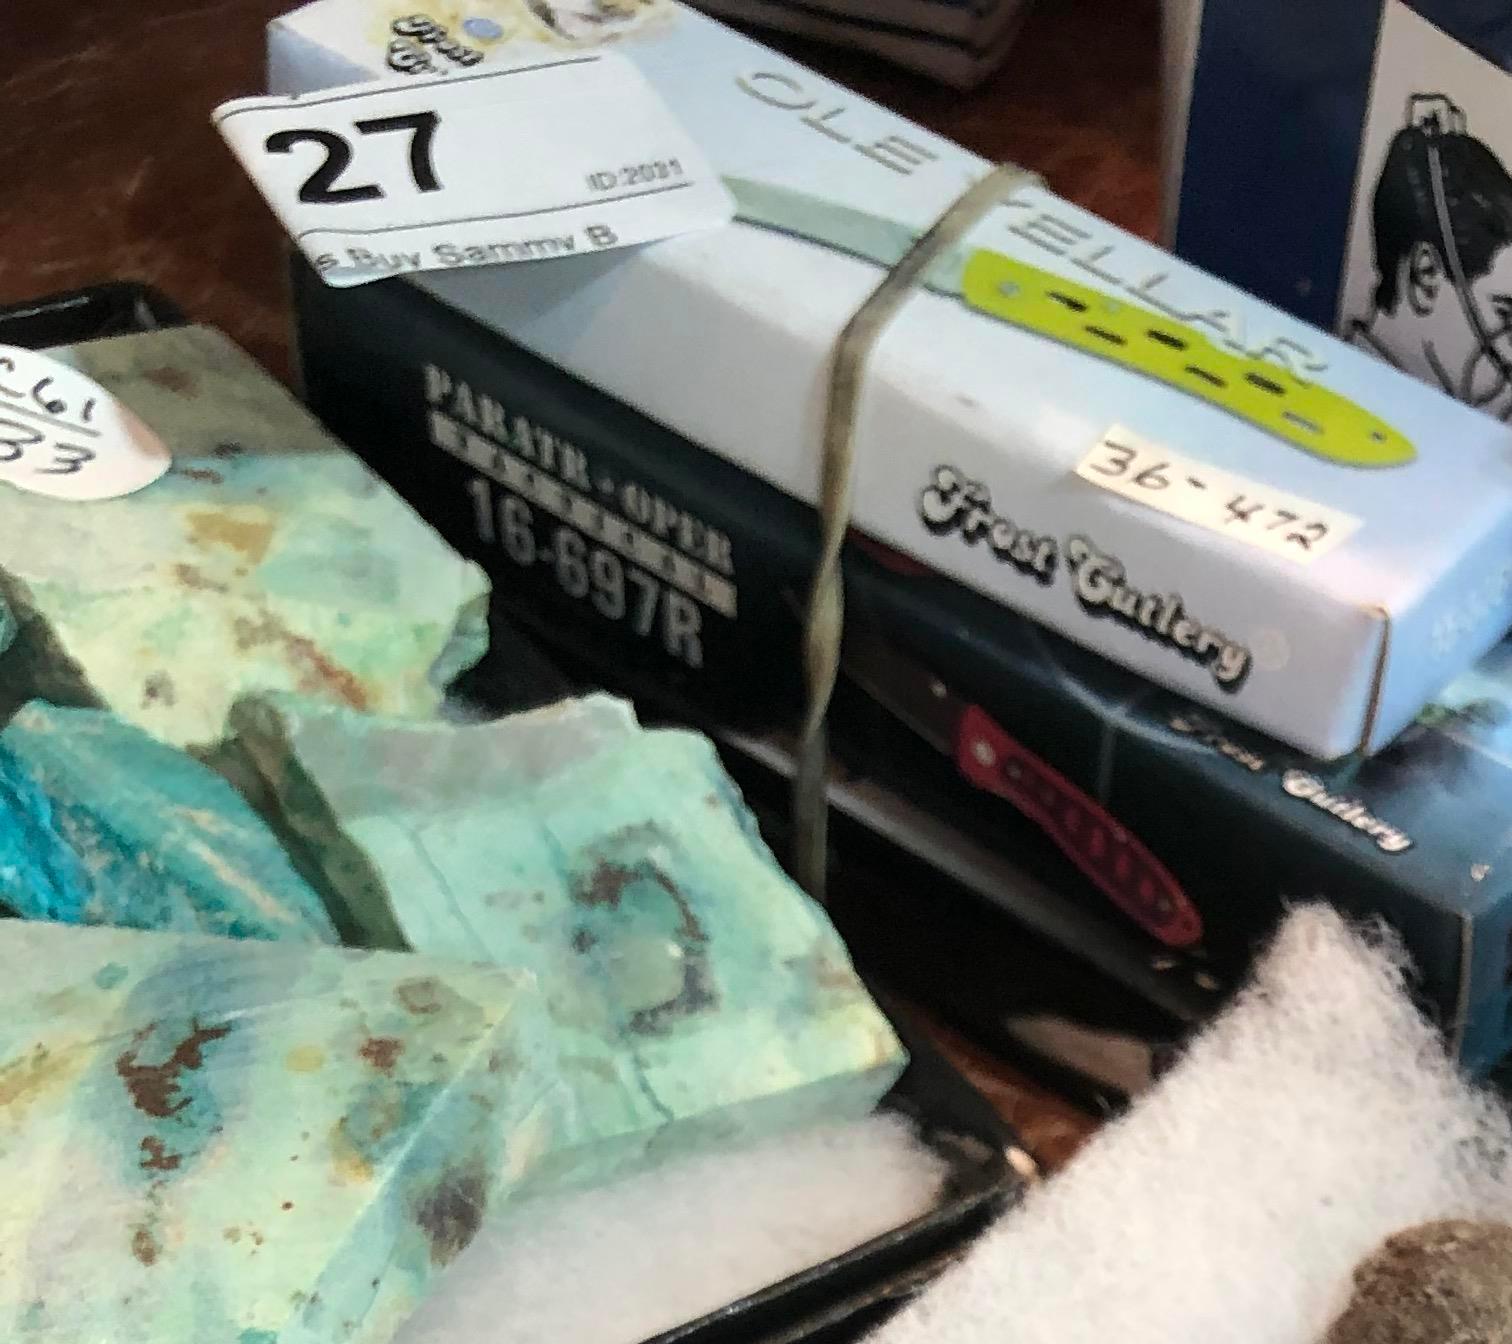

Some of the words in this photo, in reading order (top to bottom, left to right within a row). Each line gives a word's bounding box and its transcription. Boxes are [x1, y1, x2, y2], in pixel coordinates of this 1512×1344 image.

[265, 109, 443, 204] 27
[586, 157, 684, 192] ID:2031
[432, 232, 576, 267] Sammy
[585, 223, 619, 248] B
[1000, 198, 1331, 390] ELLAR
[917, 464, 1060, 587] Frost
[1064, 533, 1254, 693] Cutlery
[1281, 767, 1415, 854] Cutlery
